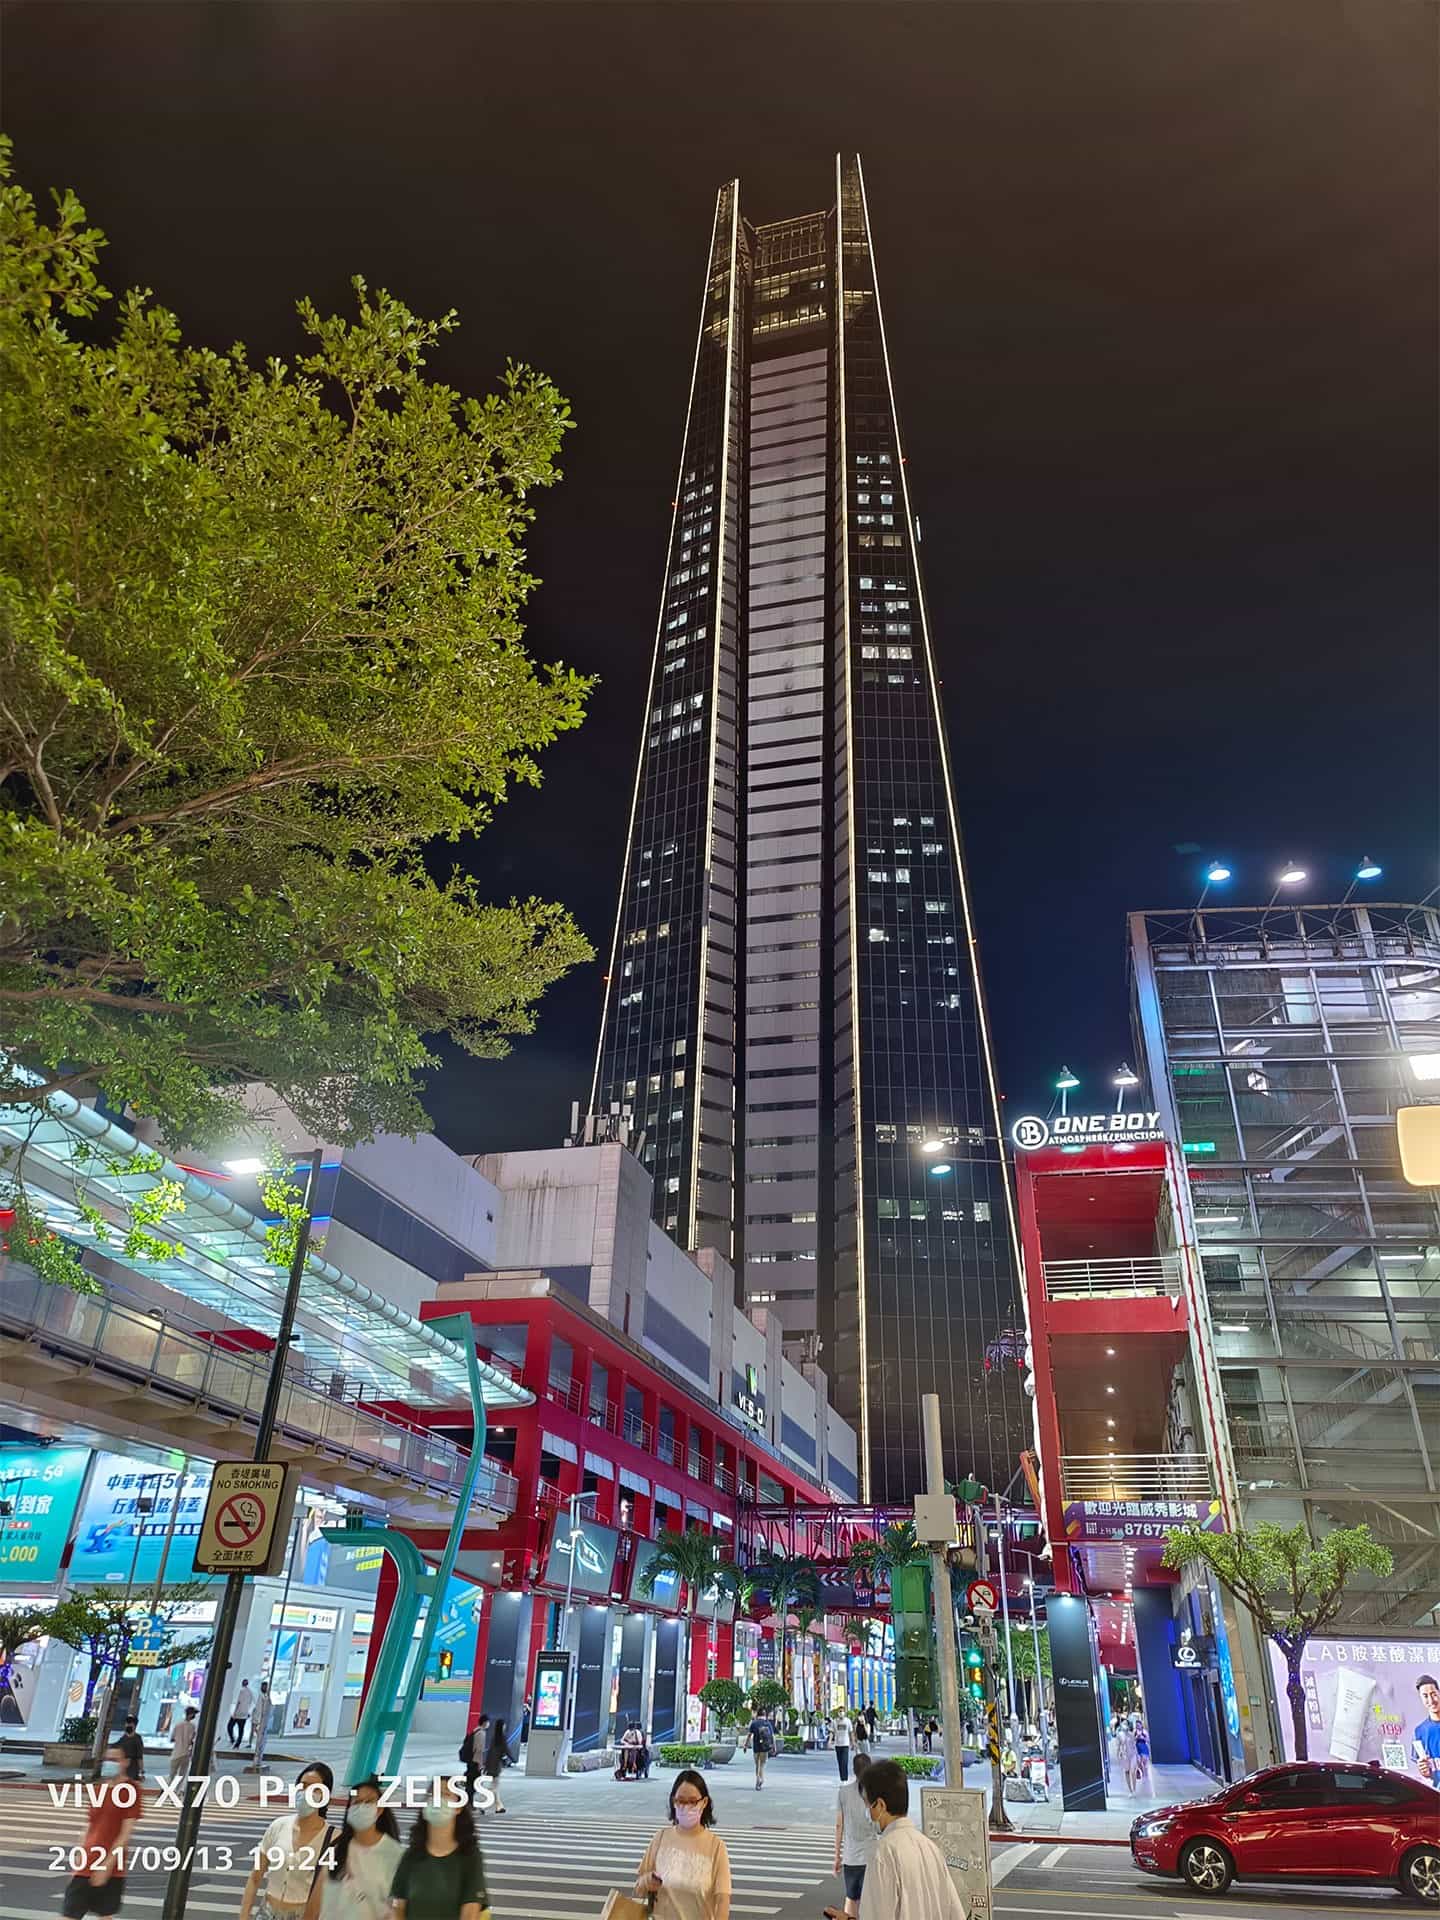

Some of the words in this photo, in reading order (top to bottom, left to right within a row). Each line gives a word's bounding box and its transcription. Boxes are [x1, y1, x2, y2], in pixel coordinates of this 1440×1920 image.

[1054, 1115, 1107, 1134] ONE
[1110, 1112, 1160, 1131] BOY
[43, 1464, 64, 1482] 5G
[216, 1479, 232, 1489] NO
[233, 1479, 280, 1490] SMOKING
[1084, 1501, 1199, 1519] 歡迎光臨威秀影城
[1124, 1522, 1201, 1537] 878756
[211, 1550, 255, 1561] 全面禁菸
